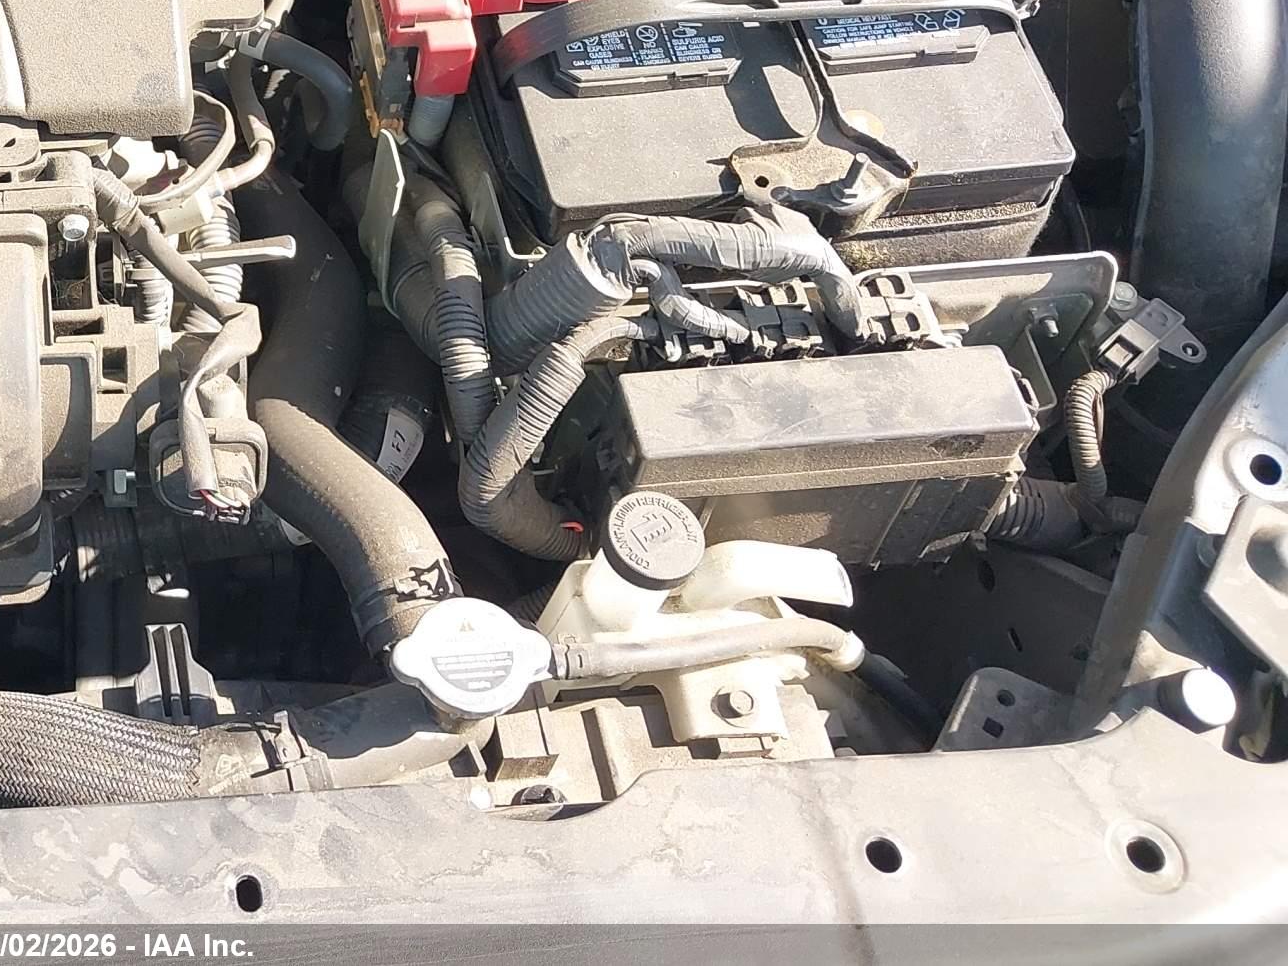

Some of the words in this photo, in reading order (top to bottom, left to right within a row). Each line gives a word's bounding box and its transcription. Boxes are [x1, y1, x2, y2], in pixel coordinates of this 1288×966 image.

[600, 30, 626, 38] SHIELD
[602, 37, 621, 45] EYES
[672, 37, 706, 46] SULFURIC
[708, 35, 724, 43] ACID
[587, 43, 625, 52] EXPLOSIVE
[643, 41, 656, 49] NO
[589, 51, 612, 59] GASES
[676, 48, 710, 57] BLINDNESS
[603, 56, 633, 64] BLINDNESS
